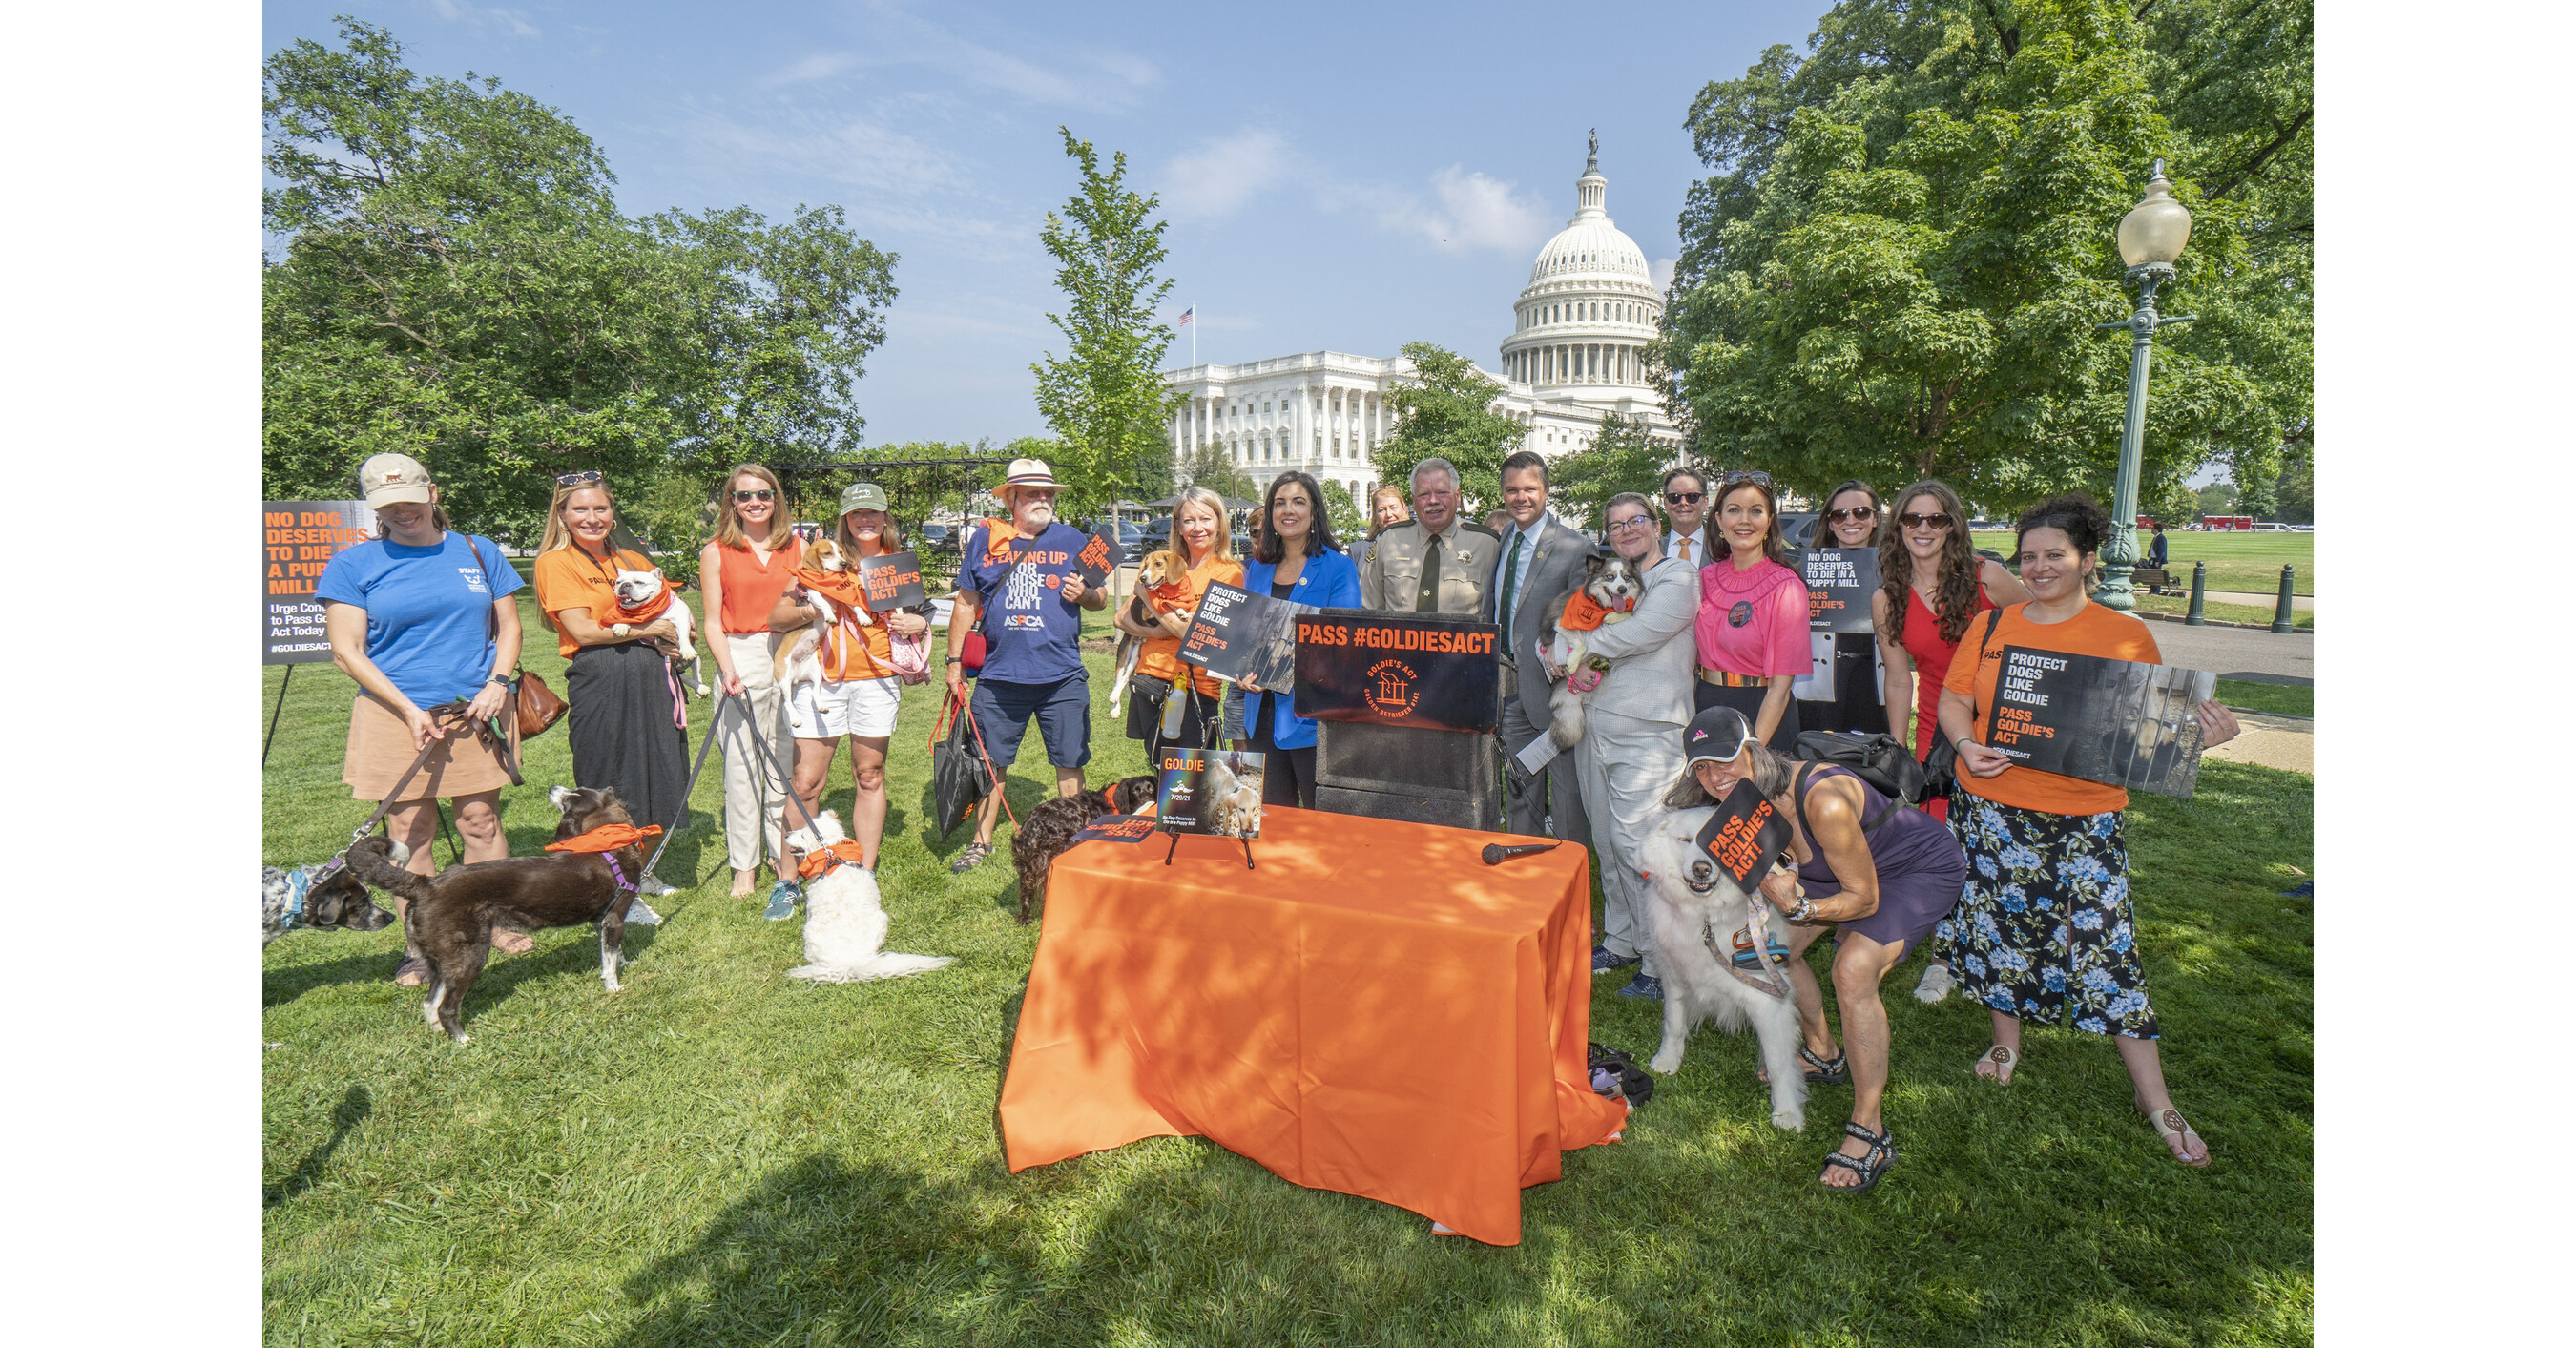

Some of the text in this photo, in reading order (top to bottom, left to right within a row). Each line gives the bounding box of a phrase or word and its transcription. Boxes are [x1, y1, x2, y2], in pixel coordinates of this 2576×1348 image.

[265, 511, 342, 527] NO DOG
[266, 529, 368, 544] DESERVES
[1091, 534, 1110, 555] PASS
[266, 546, 293, 561] TO
[300, 545, 332, 561] DIE
[1049, 551, 1068, 565] UP
[1079, 550, 1095, 569] ACT!
[1086, 542, 1112, 574] GOLDIE'S
[268, 562, 328, 578] A PUP
[866, 565, 896, 580] PASS
[269, 579, 318, 594] MILL
[868, 571, 921, 591] GOLDIE'S
[1806, 579, 1859, 588] PUPPY MILL
[870, 587, 898, 602] ACT!
[1008, 585, 1039, 598] WHO
[1211, 585, 1247, 603] PROTECT
[1005, 596, 1042, 610] CAN'T
[1204, 602, 1223, 614] LIKE
[1207, 593, 1231, 608] DOGS
[1809, 600, 1845, 609] OLDIE'S
[271, 604, 297, 615] Urge
[271, 616, 282, 625] to
[285, 614, 312, 624] Pass
[1004, 615, 1045, 627] ASPCA
[1200, 611, 1230, 627] GOLDIE
[271, 626, 325, 637] Act Today
[1195, 622, 1216, 636] PASS
[1186, 639, 1204, 652] ACT
[1191, 631, 1228, 650] GOLDIE'S
[1298, 624, 1495, 654] PASS #GOLDIESACT
[271, 643, 332, 653] #GOLDIESACT
[1984, 651, 2003, 660] PAS
[1367, 659, 1418, 680] GOLDIE'S ACT
[2009, 653, 2068, 672] PROTECT
[2007, 665, 2043, 680] DOGS
[2005, 676, 2034, 692] LIKE
[1364, 689, 1380, 712] GOLDEN
[1380, 706, 1412, 717] RETRIEVER
[2003, 689, 2049, 707] GOLDIE
[1999, 706, 2033, 722] PASS
[1997, 718, 2055, 739] GOLDIE'S
[1994, 731, 2020, 744] ACT
[1165, 757, 1204, 772] GOLDIE
[1086, 824, 1151, 833] GOLDIE'S
[1105, 829, 1145, 838] PASS
[1708, 814, 1744, 858] PASS
[1720, 800, 1773, 868] GOLDIE'S
[1732, 841, 1762, 881] ACT!
